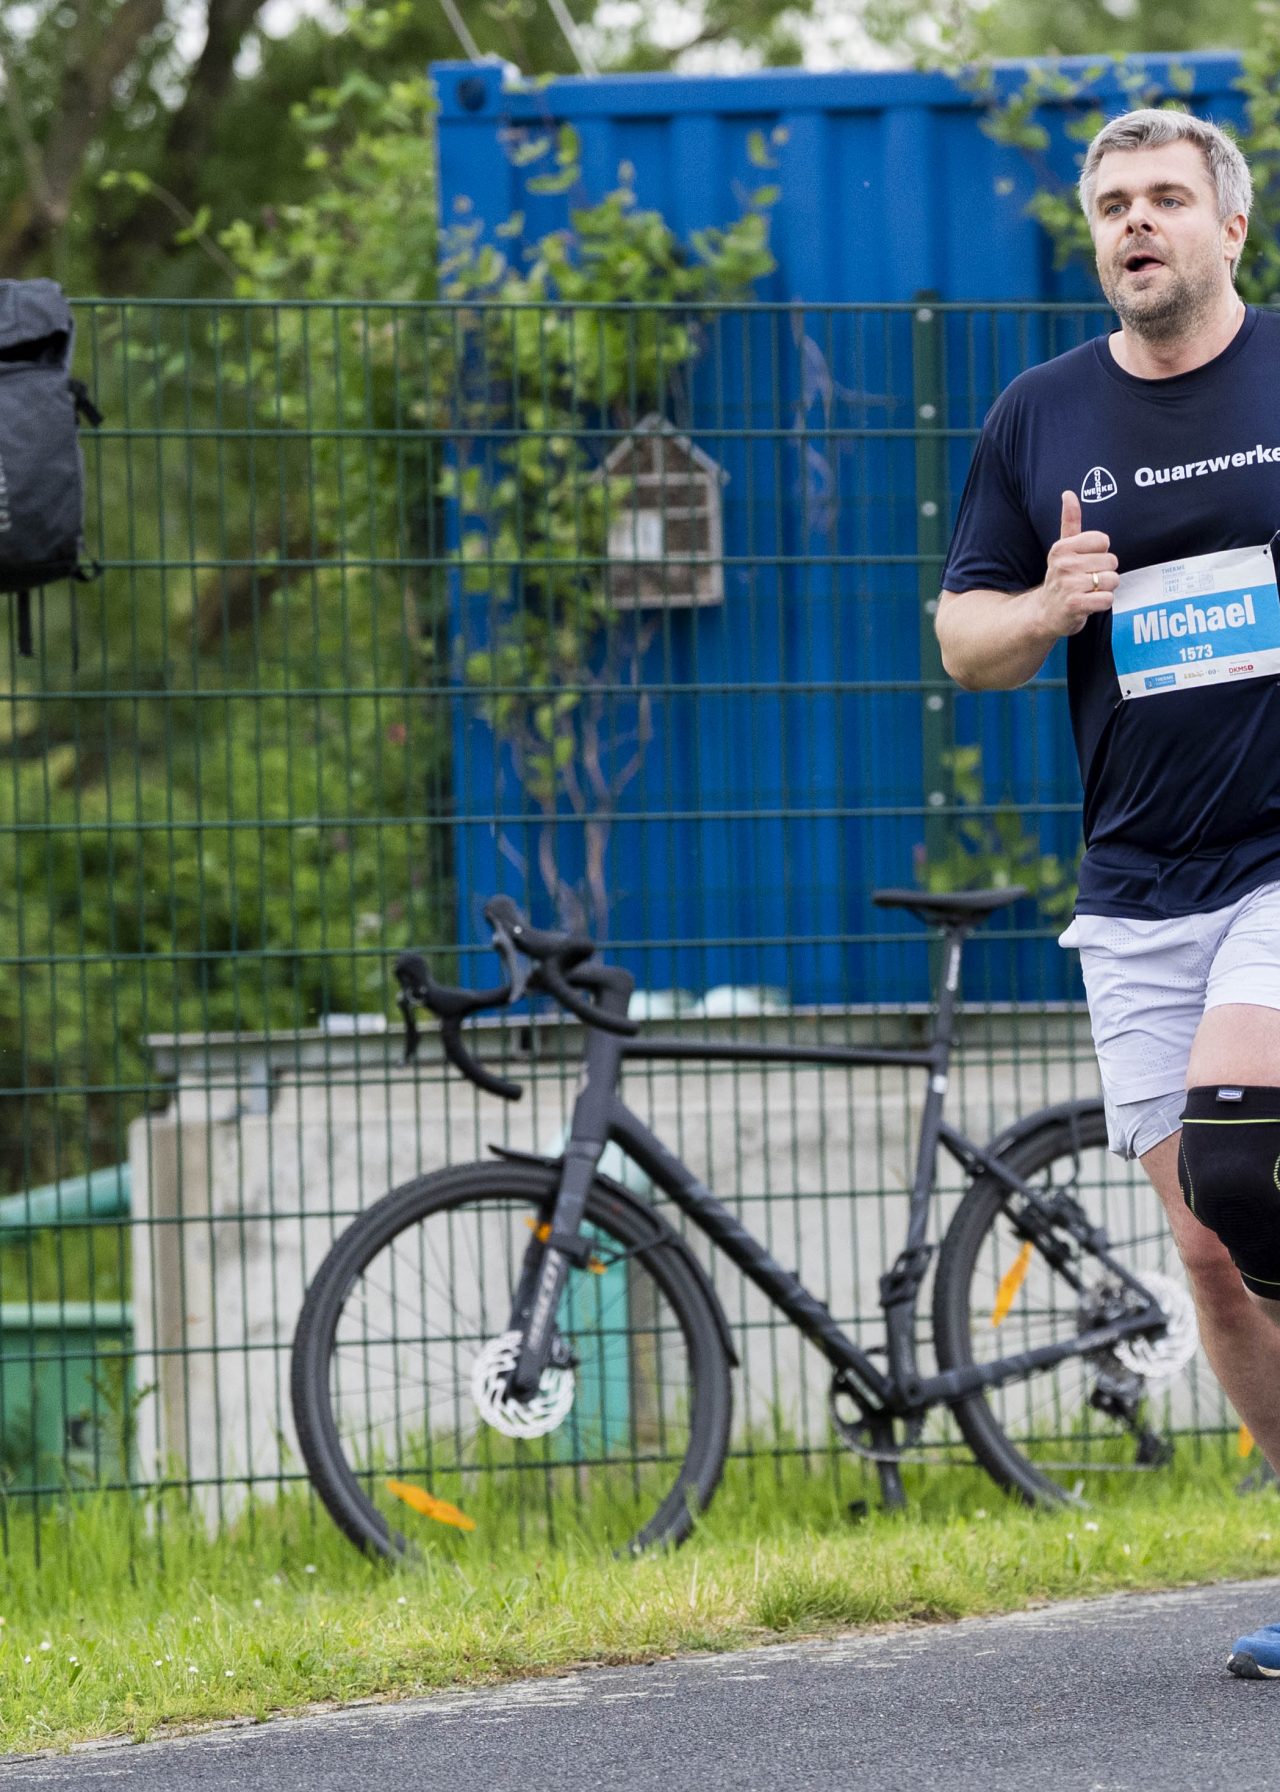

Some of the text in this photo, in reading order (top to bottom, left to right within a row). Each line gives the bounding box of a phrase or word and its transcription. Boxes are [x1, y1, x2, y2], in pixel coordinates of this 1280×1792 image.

[1133, 594, 1256, 645] Michael
[1179, 643, 1214, 662] 1573
[1228, 665, 1249, 674] DKMS
